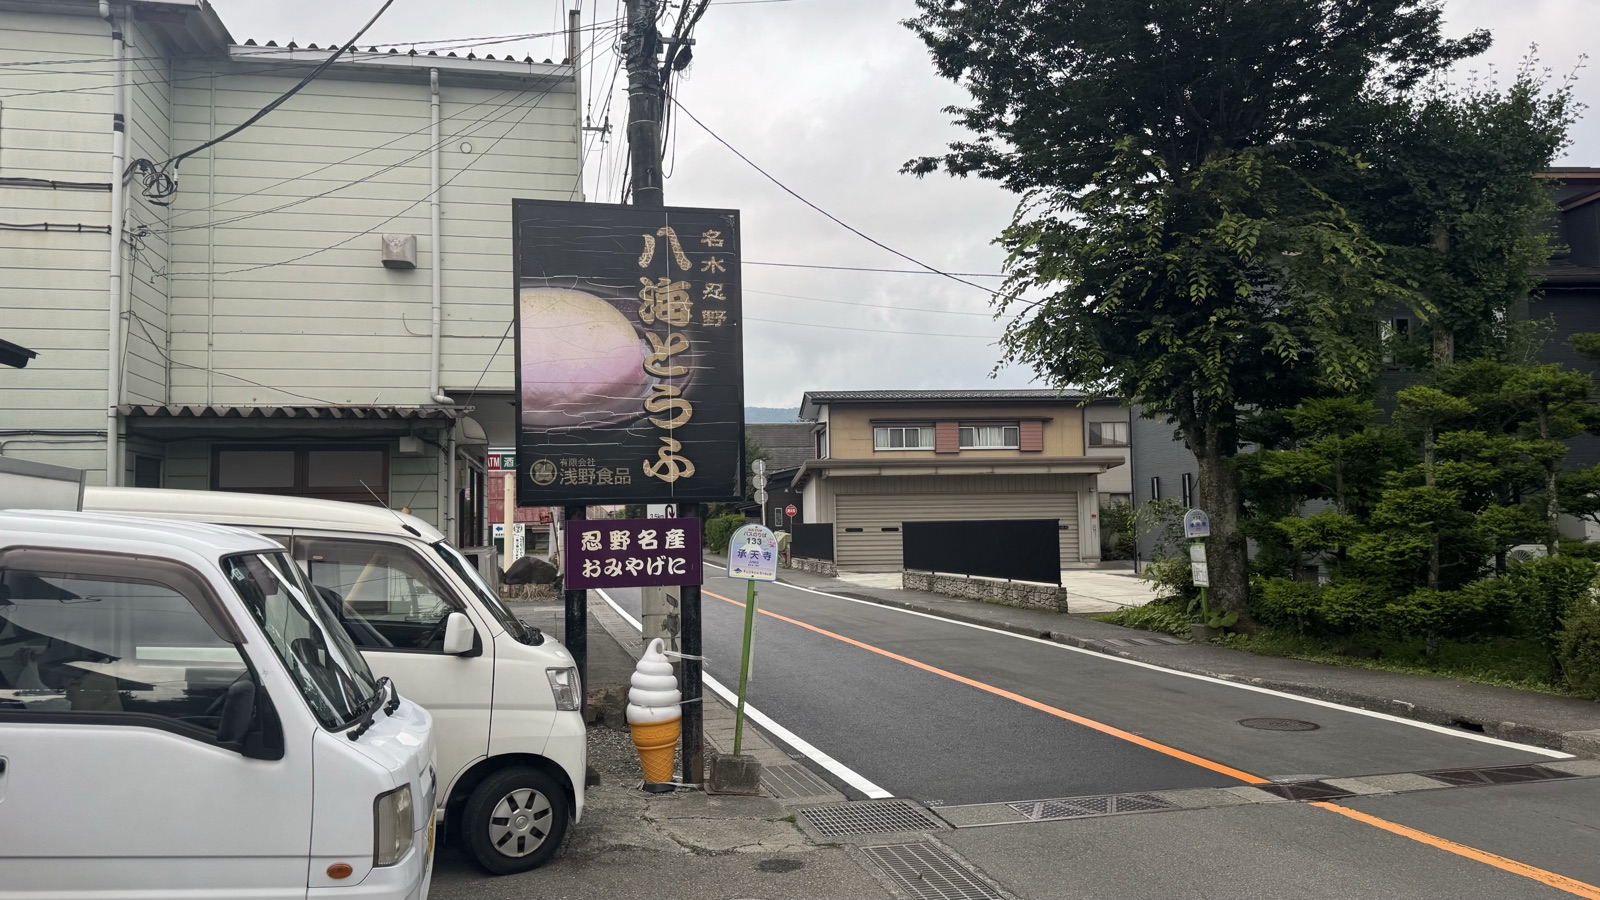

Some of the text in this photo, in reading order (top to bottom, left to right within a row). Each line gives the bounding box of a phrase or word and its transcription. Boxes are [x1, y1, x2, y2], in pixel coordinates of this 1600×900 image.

[700, 229, 727, 328] 名水忍野
[638, 226, 696, 483] 八海とうふ
[503, 457, 514, 468] 酒
[559, 458, 596, 467] 有限会社
[559, 467, 632, 486] 浅野食品
[581, 528, 686, 551] 忍野名産
[747, 537, 762, 545] 133
[737, 548, 772, 561] 承天寺
[582, 554, 687, 578] おみやげに
